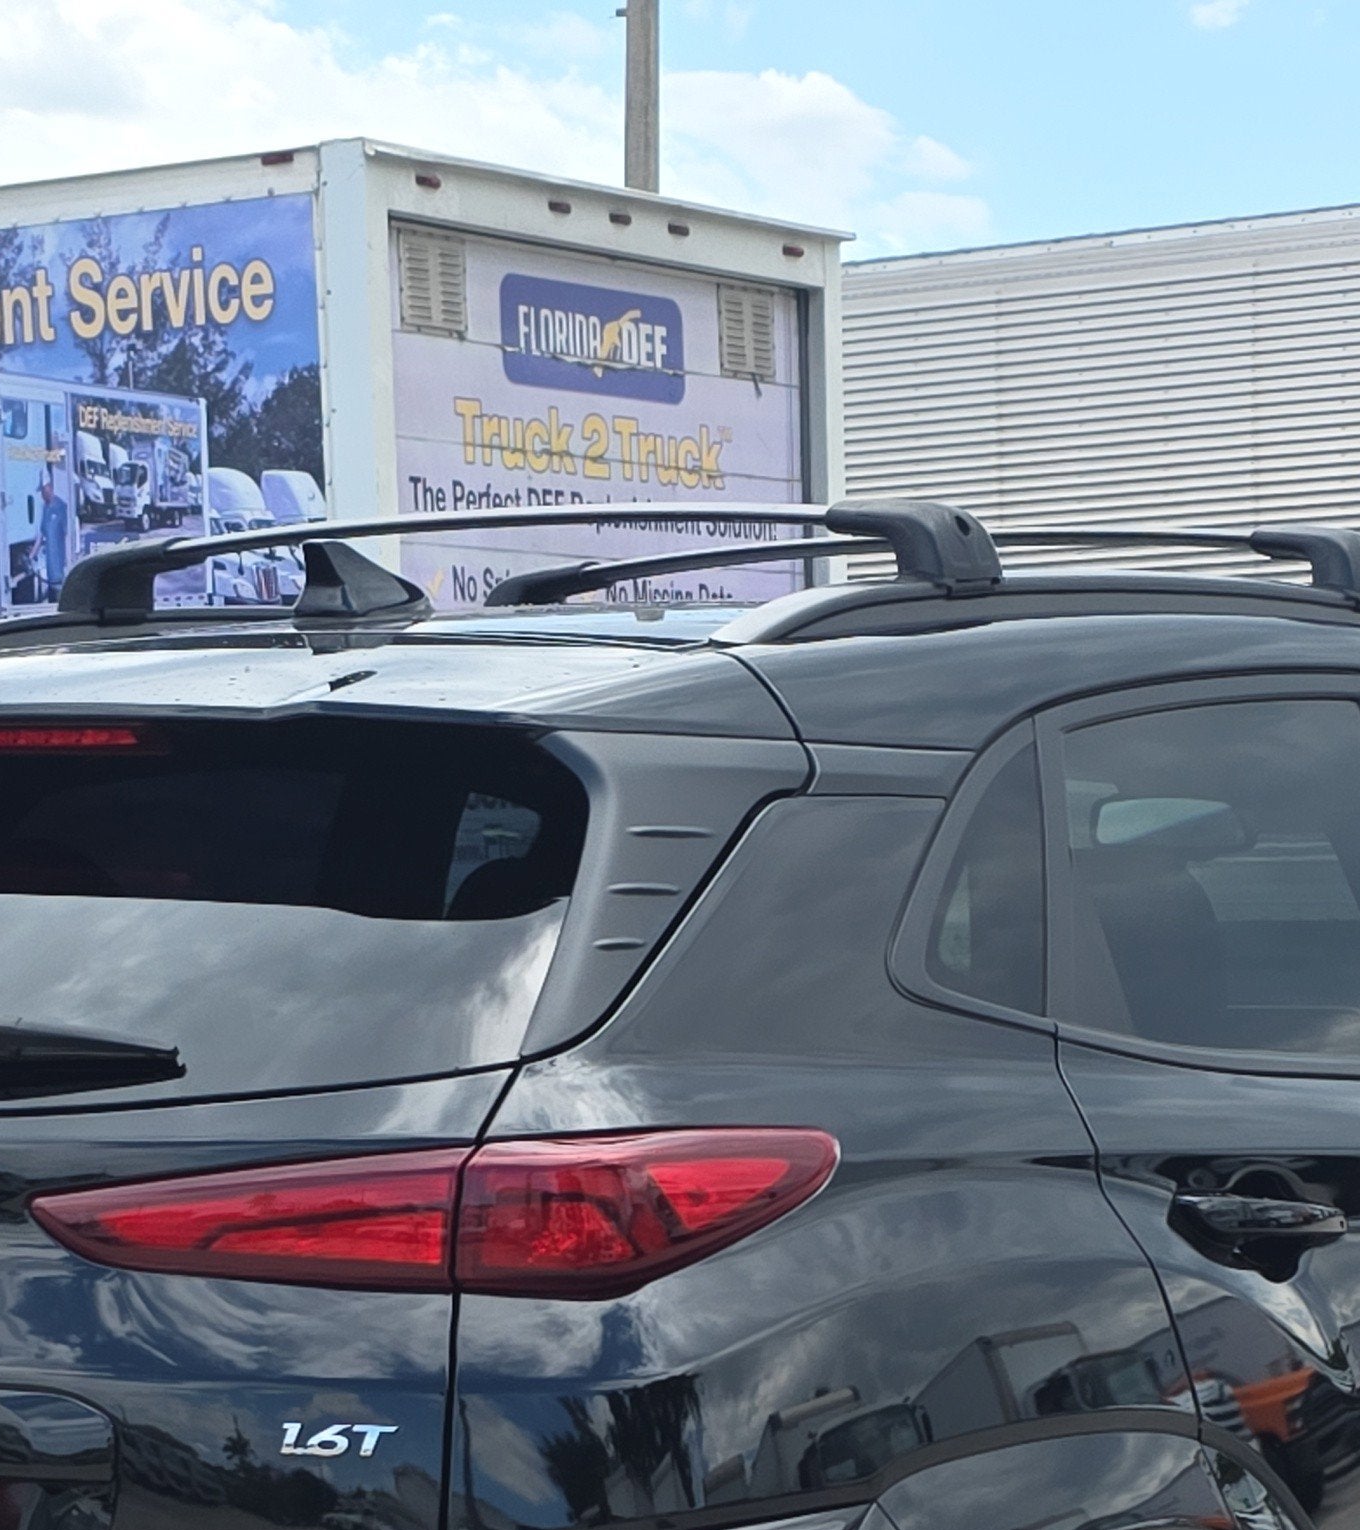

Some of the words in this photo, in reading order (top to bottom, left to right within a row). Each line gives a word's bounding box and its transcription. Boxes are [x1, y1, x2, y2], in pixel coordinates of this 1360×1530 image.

[67, 246, 277, 340] Service
[518, 304, 601, 359] FLORIDA
[621, 320, 667, 369] DEF
[453, 396, 578, 475] Truck
[581, 413, 612, 479] 2
[612, 415, 726, 490] Truck
[408, 475, 446, 511] The
[452, 564, 477, 602] No
[280, 1422, 399, 1457] 1.6T
